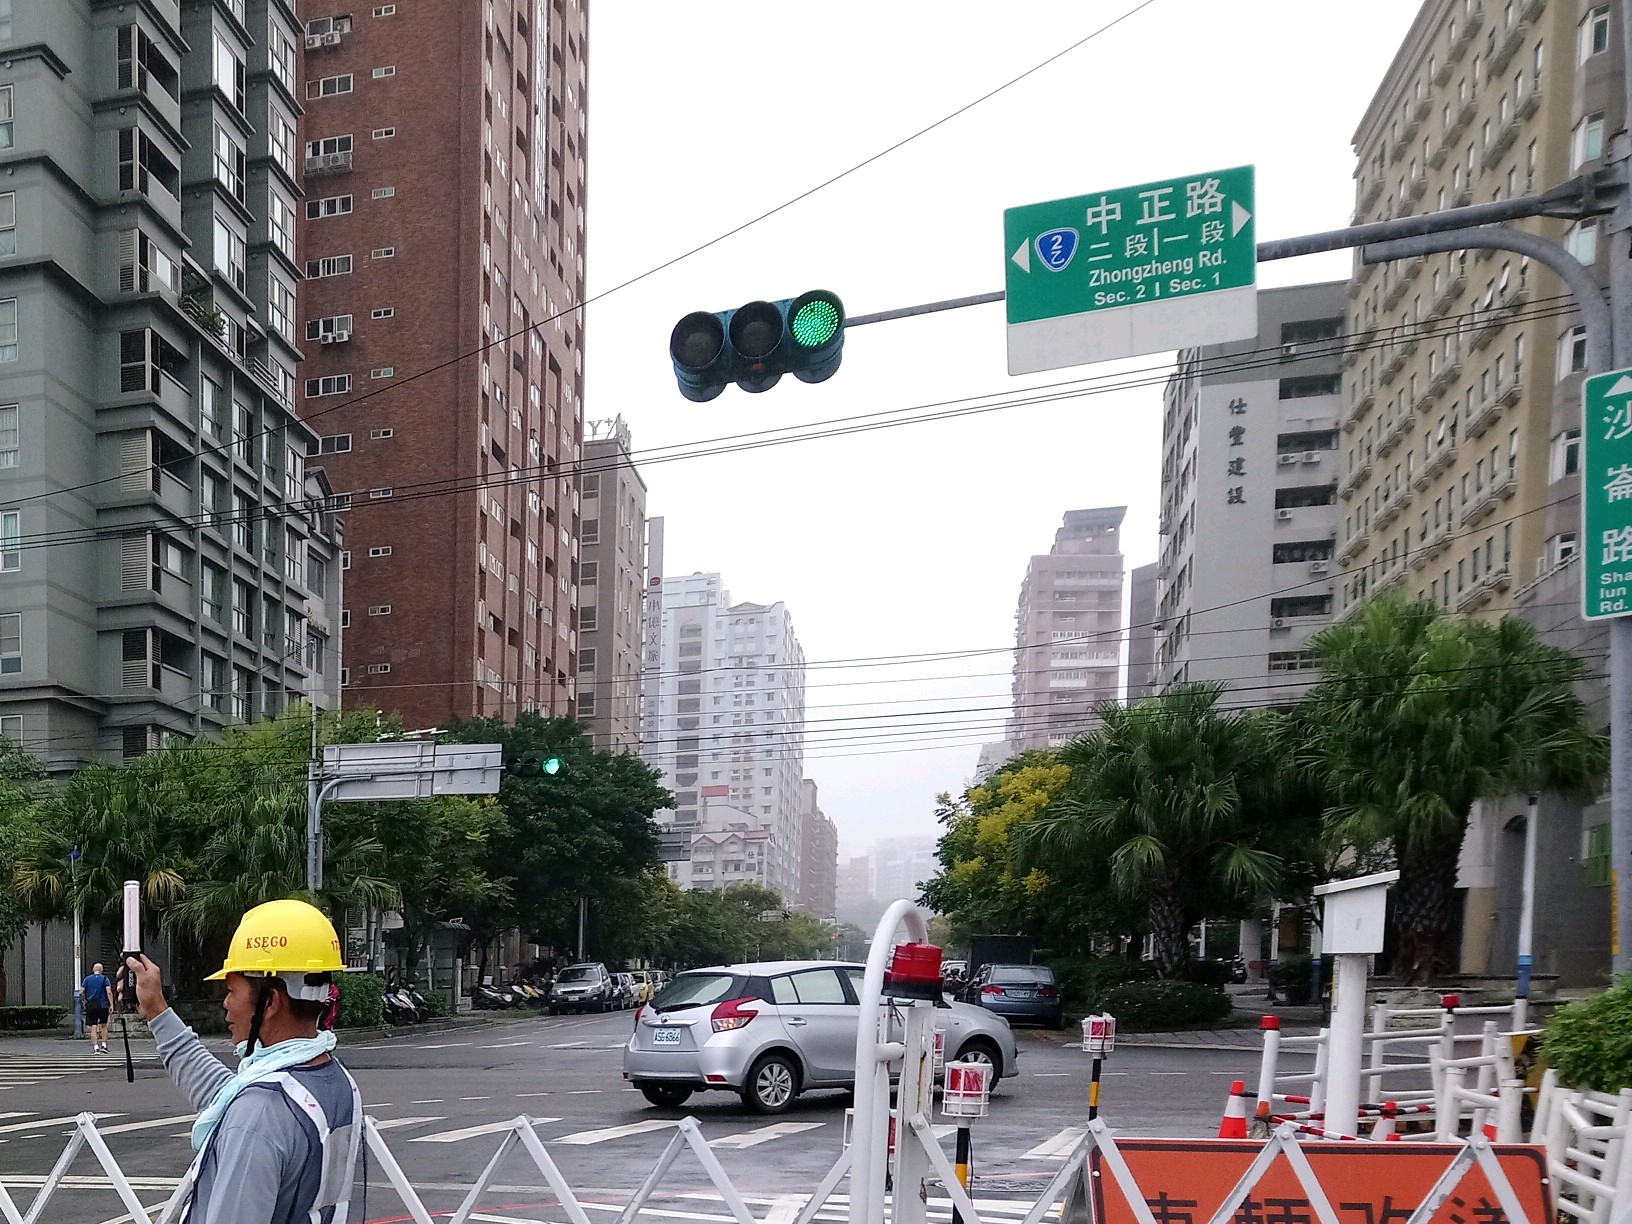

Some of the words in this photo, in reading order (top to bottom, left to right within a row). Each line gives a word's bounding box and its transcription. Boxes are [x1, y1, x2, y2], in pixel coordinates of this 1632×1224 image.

[1085, 178, 1226, 235] 中正路
[1050, 235, 1063, 250] 2
[1088, 233, 1149, 262] 二段
[1163, 219, 1225, 246] 一段
[1088, 257, 1194, 287] Zhongzheng
[1198, 248, 1227, 269] Rd.
[1094, 291, 1131, 306] Sec.
[1135, 284, 1146, 299] 2
[1169, 278, 1207, 293] Sec.
[1211, 272, 1220, 286] 1
[1599, 598, 1629, 613] Rd.
